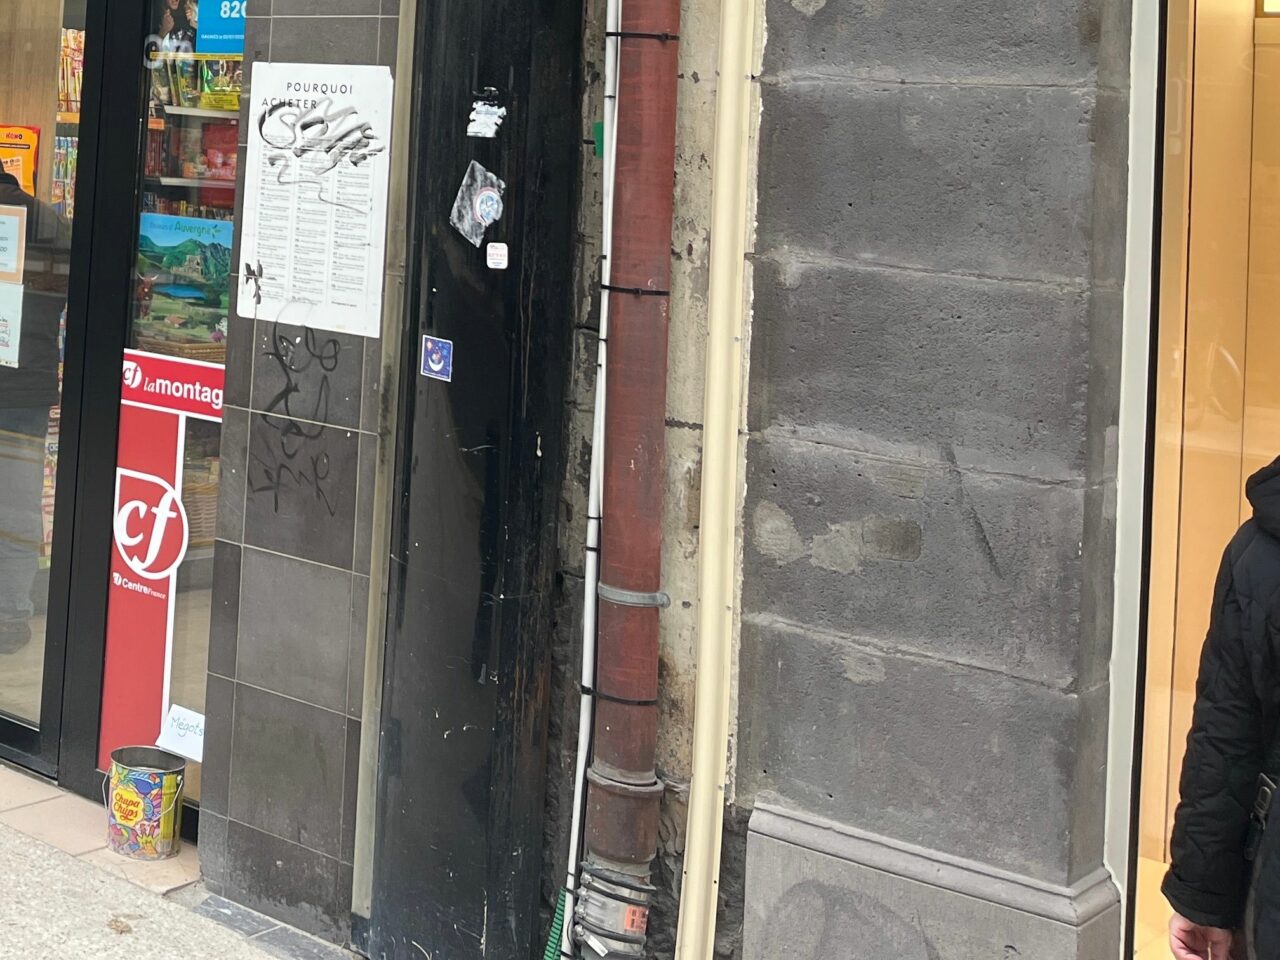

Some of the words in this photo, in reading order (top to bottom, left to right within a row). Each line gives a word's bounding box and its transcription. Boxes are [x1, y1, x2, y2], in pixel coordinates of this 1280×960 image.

[286, 81, 353, 95] POURQUOI
[261, 97, 318, 109] ACHETER
[170, 715, 204, 738] Mégots
[114, 793, 141, 809] Chupa
[113, 803, 139, 822] Chups
